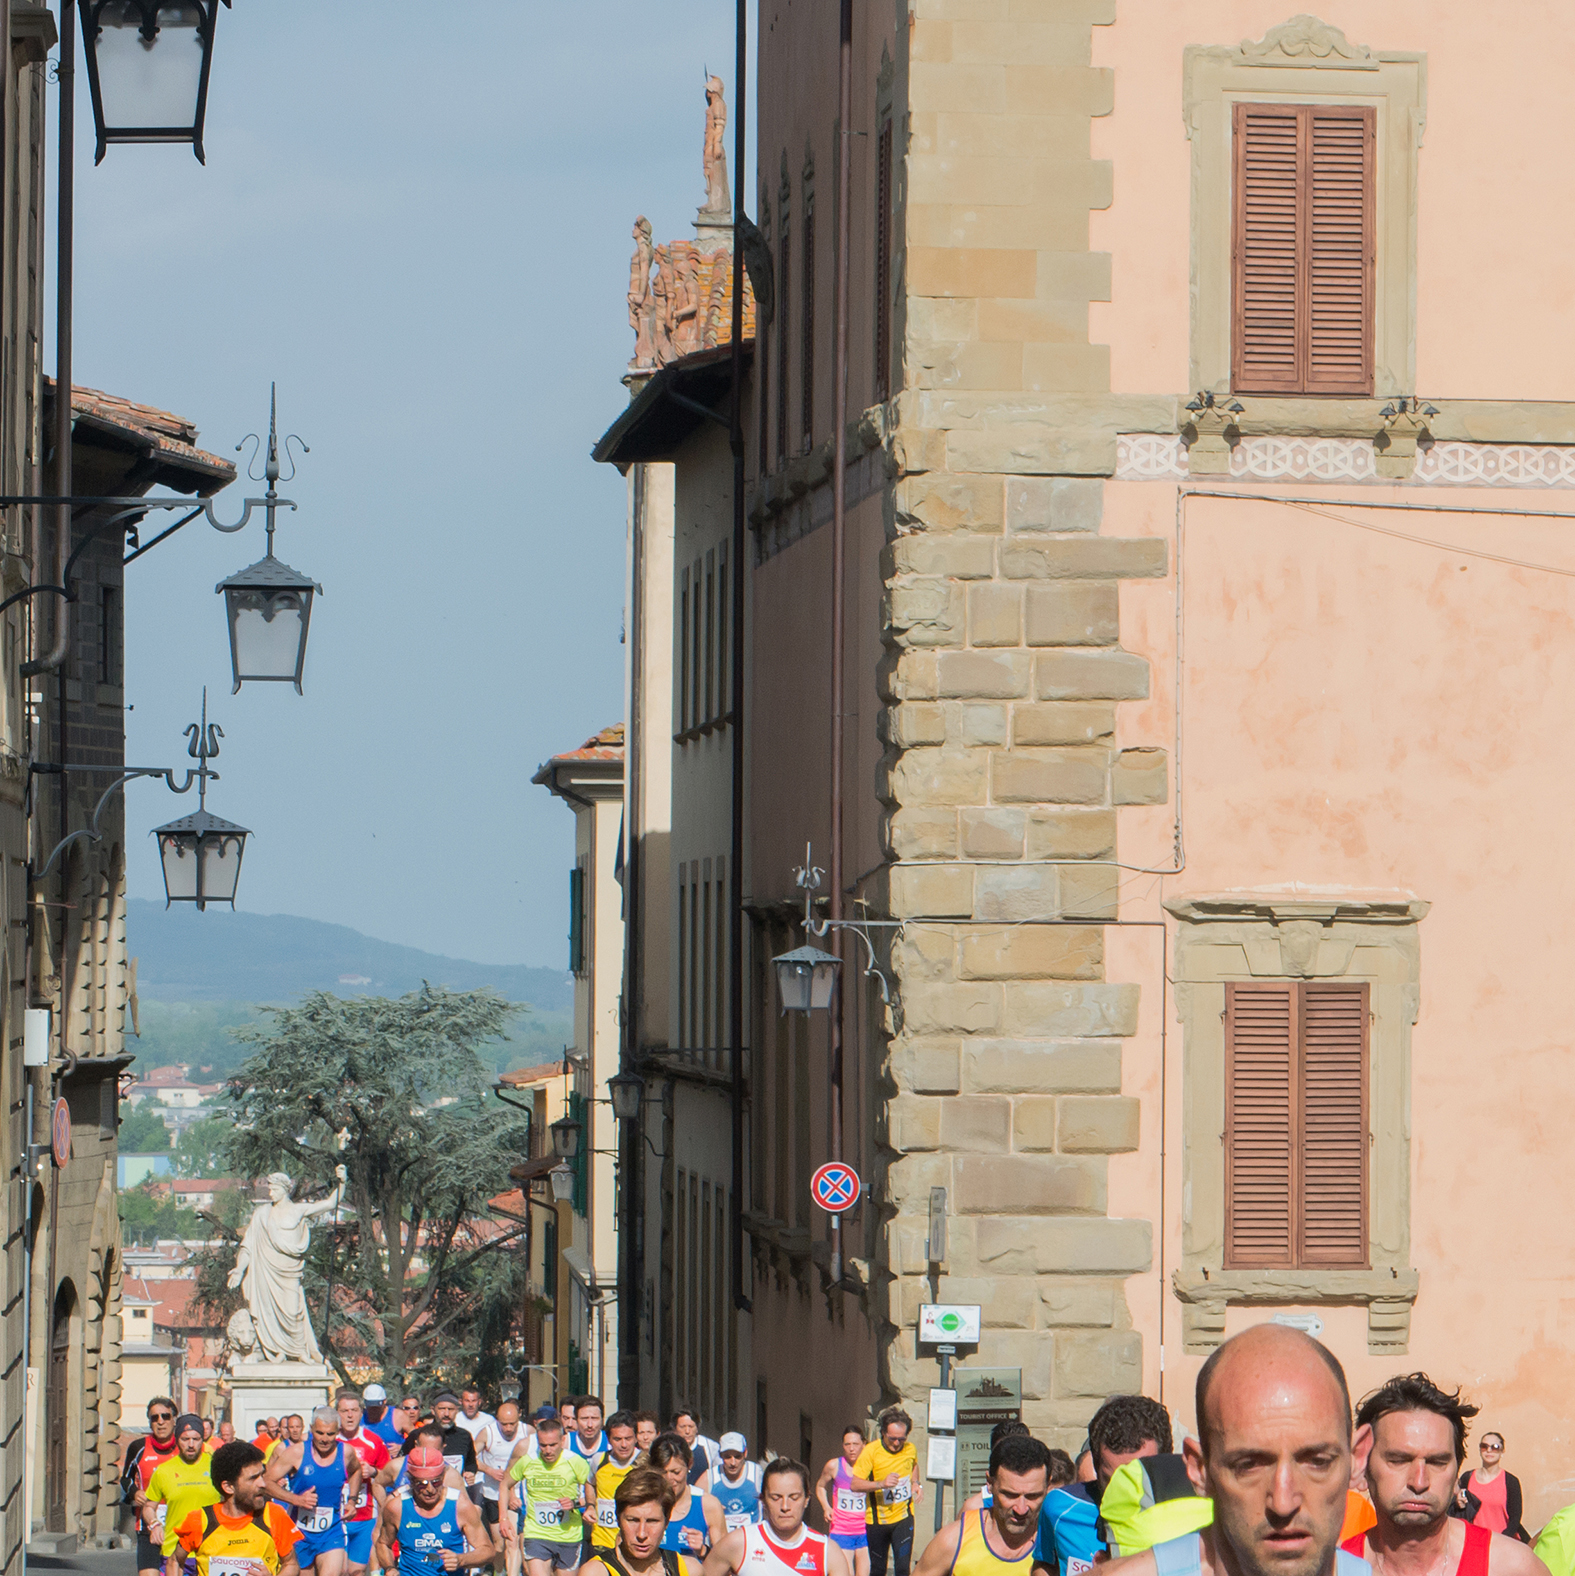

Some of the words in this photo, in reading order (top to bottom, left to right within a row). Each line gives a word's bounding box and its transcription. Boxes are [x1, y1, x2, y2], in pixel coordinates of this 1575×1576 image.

[959, 1412, 985, 1420] TOURIST
[986, 1412, 1008, 1420] OFFICE
[885, 1486, 908, 1502] 453
[840, 1499, 864, 1510] 513
[300, 1516, 329, 1530] 410
[538, 1510, 565, 1525] 309
[600, 1510, 615, 1525] 48
